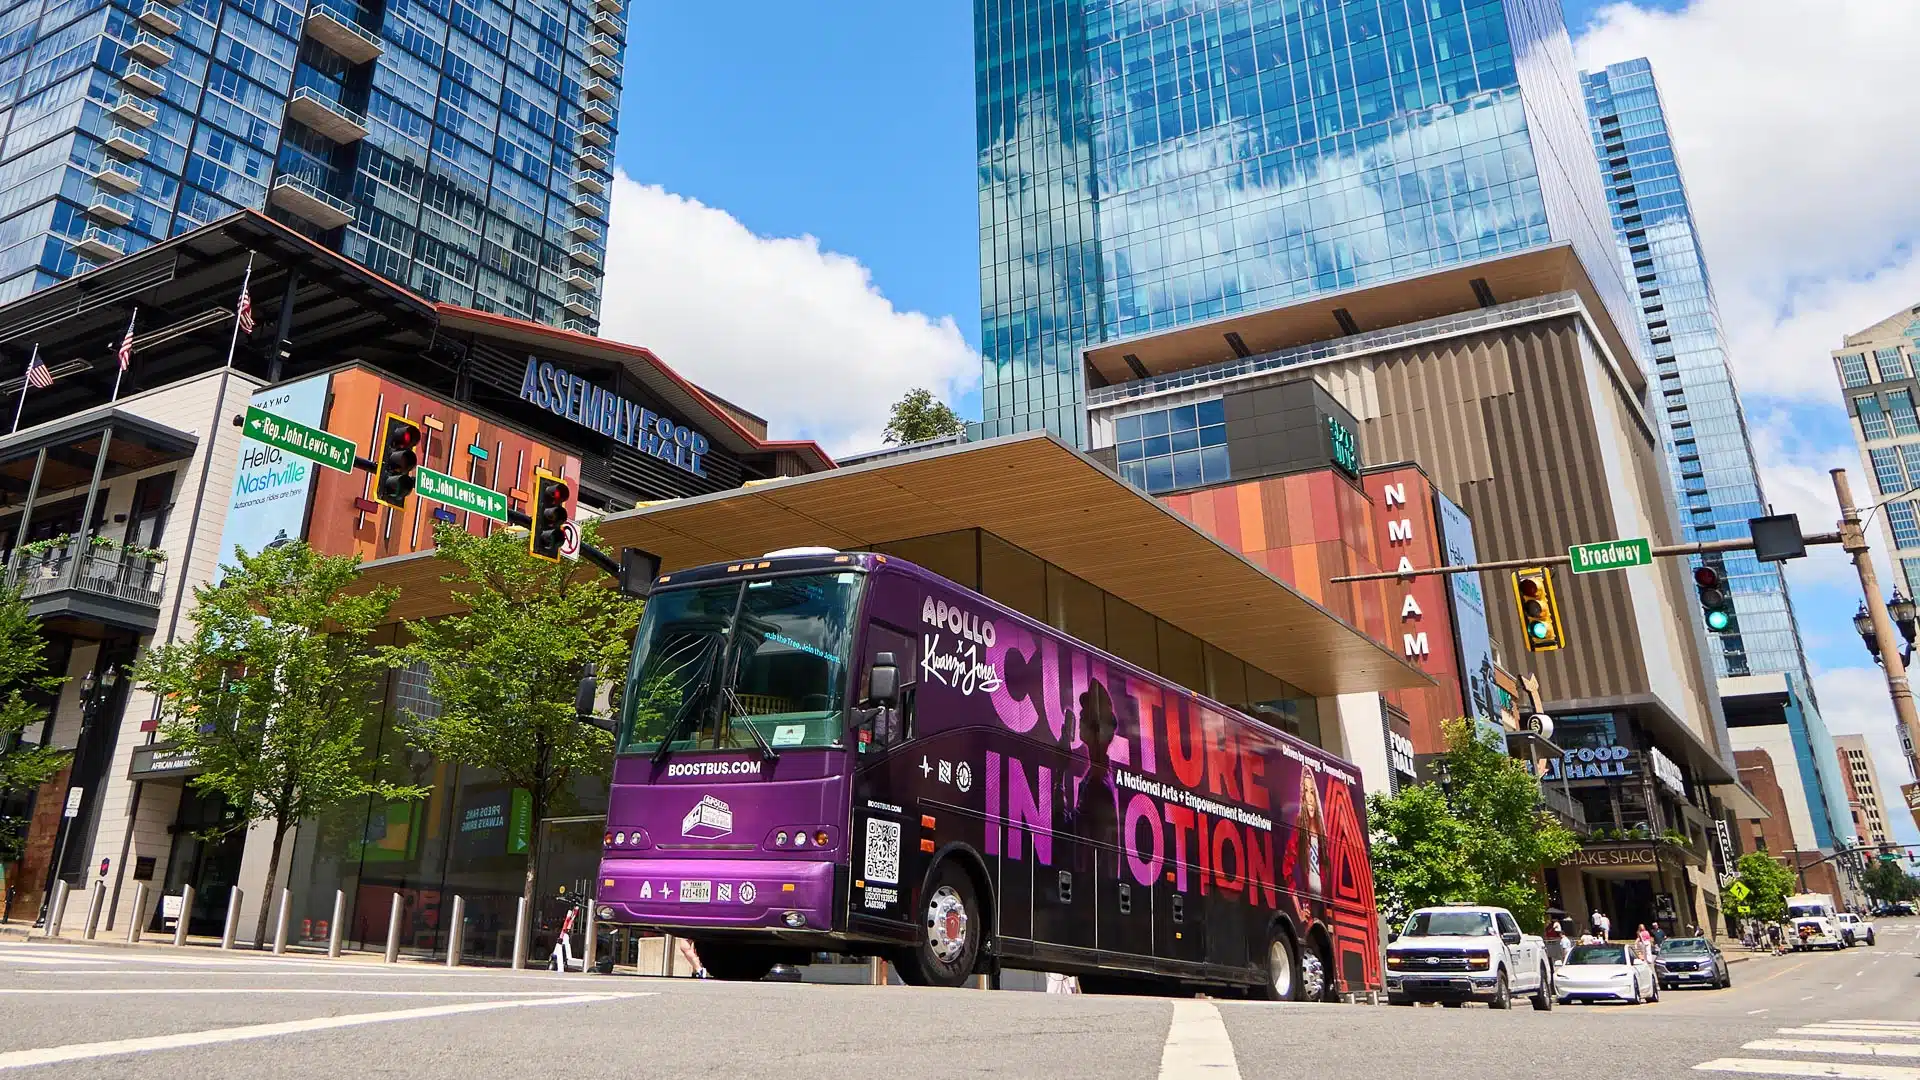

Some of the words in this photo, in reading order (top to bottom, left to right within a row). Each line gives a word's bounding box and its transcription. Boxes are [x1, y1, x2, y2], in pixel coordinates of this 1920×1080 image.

[520, 354, 640, 446] ASSEMBLY
[262, 416, 280, 441] Rep.
[281, 424, 302, 447] John
[303, 431, 328, 456] Lewis
[329, 445, 342, 463] Way
[342, 447, 350, 465] S
[639, 407, 710, 456] FOOD
[242, 445, 283, 470] Hello,
[638, 429, 707, 479] HALL
[236, 461, 305, 497] Nashville
[420, 471, 436, 494] Rep.
[435, 478, 453, 498] John
[454, 483, 476, 505] Lewis
[487, 496, 494, 512] N
[233, 498, 266, 510] Autonomous
[266, 493, 279, 503] rides
[1578, 543, 1640, 566] Broadway
[922, 595, 996, 647] APOLLO
[921, 633, 966, 688] Kwanza
[962, 644, 1003, 695] Jones
[1389, 730, 1414, 759] FOOD
[1563, 745, 1629, 763] FOOD
[668, 761, 761, 776] BOOSTBUS.COM
[1391, 750, 1417, 779] HALL
[1564, 761, 1633, 779] HALL
[985, 750, 1052, 866] IN
[1116, 769, 1124, 785] A
[1124, 771, 1160, 797] National
[1161, 783, 1178, 802] Arts
[1185, 791, 1238, 820] Empowerment
[1238, 808, 1272, 831] Roadshow
[1072, 774, 1276, 909] OTION
[1559, 851, 1608, 866] SHAKE
